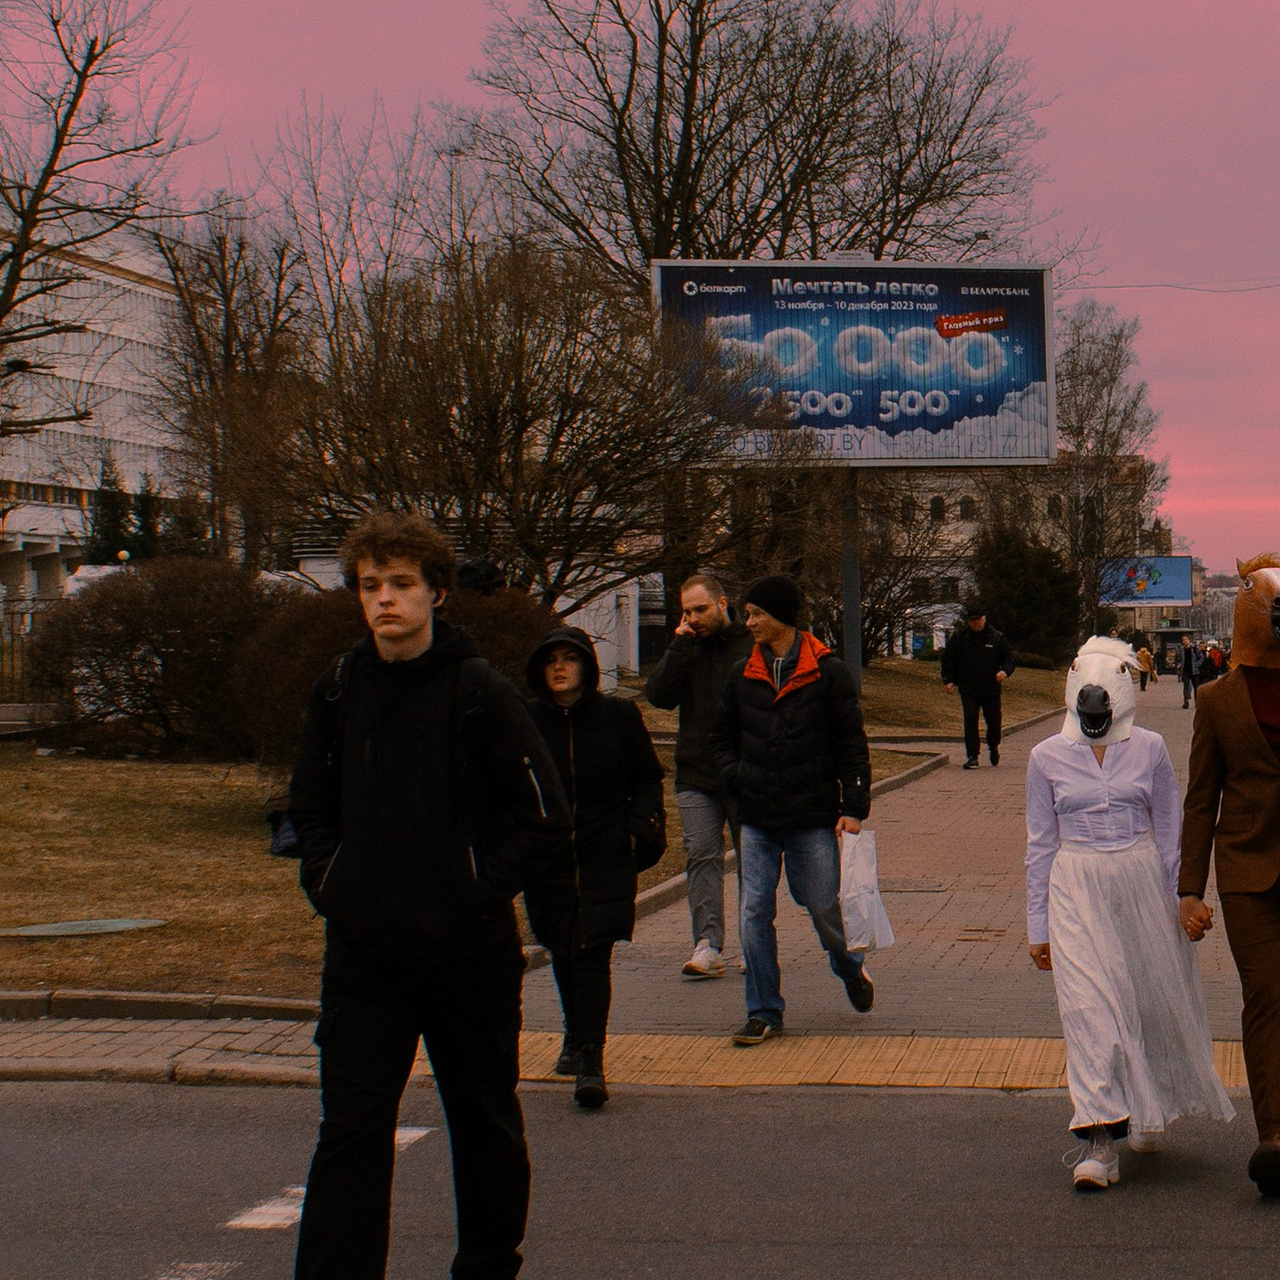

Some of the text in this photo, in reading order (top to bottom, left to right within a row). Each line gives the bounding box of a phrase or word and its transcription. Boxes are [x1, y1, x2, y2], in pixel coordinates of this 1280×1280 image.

[699, 282, 747, 296] белкарт
[771, 278, 940, 297] Мечтать легко
[968, 286, 1030, 297] БЕЛАРУСБАНК
[775, 300, 786, 310] 13
[787, 300, 825, 312] ноября
[835, 300, 847, 310] 10
[848, 300, 889, 312] декабря
[890, 301, 915, 311] 2023
[916, 302, 939, 312] года
[943, 315, 1005, 330] Главный приз
[834, 324, 1006, 384] 000
[878, 389, 950, 422] 500
[891, 434, 935, 453] +375
